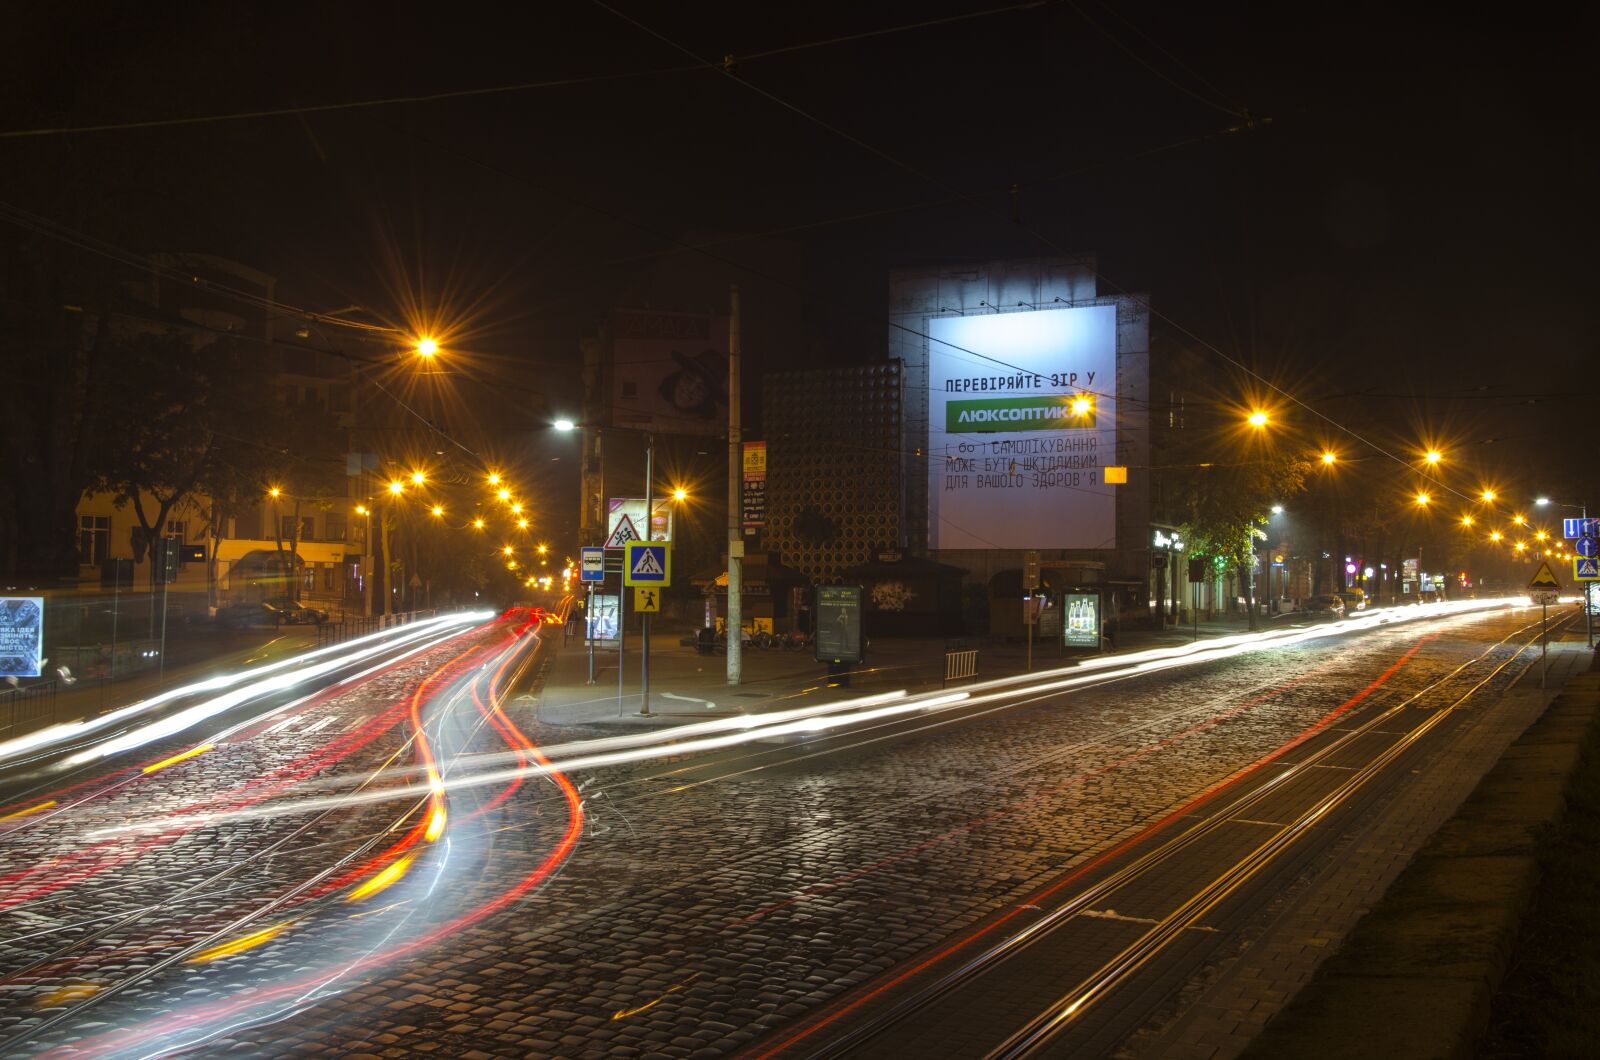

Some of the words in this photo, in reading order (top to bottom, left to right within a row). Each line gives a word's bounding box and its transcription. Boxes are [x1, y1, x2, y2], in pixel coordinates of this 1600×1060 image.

[946, 372, 1041, 392] ПЕРЕВІРЯЙТЕ
[1051, 373, 1077, 387] ЗІР
[1087, 371, 1096, 385] У
[992, 437, 1097, 455] САМОЛІКУВАННЯ
[945, 457, 976, 473] МОЖЕ
[985, 457, 1016, 473] БУТИ
[1023, 455, 1097, 472] ШКІДЛИВИМ
[945, 475, 968, 492] ДЛЯ
